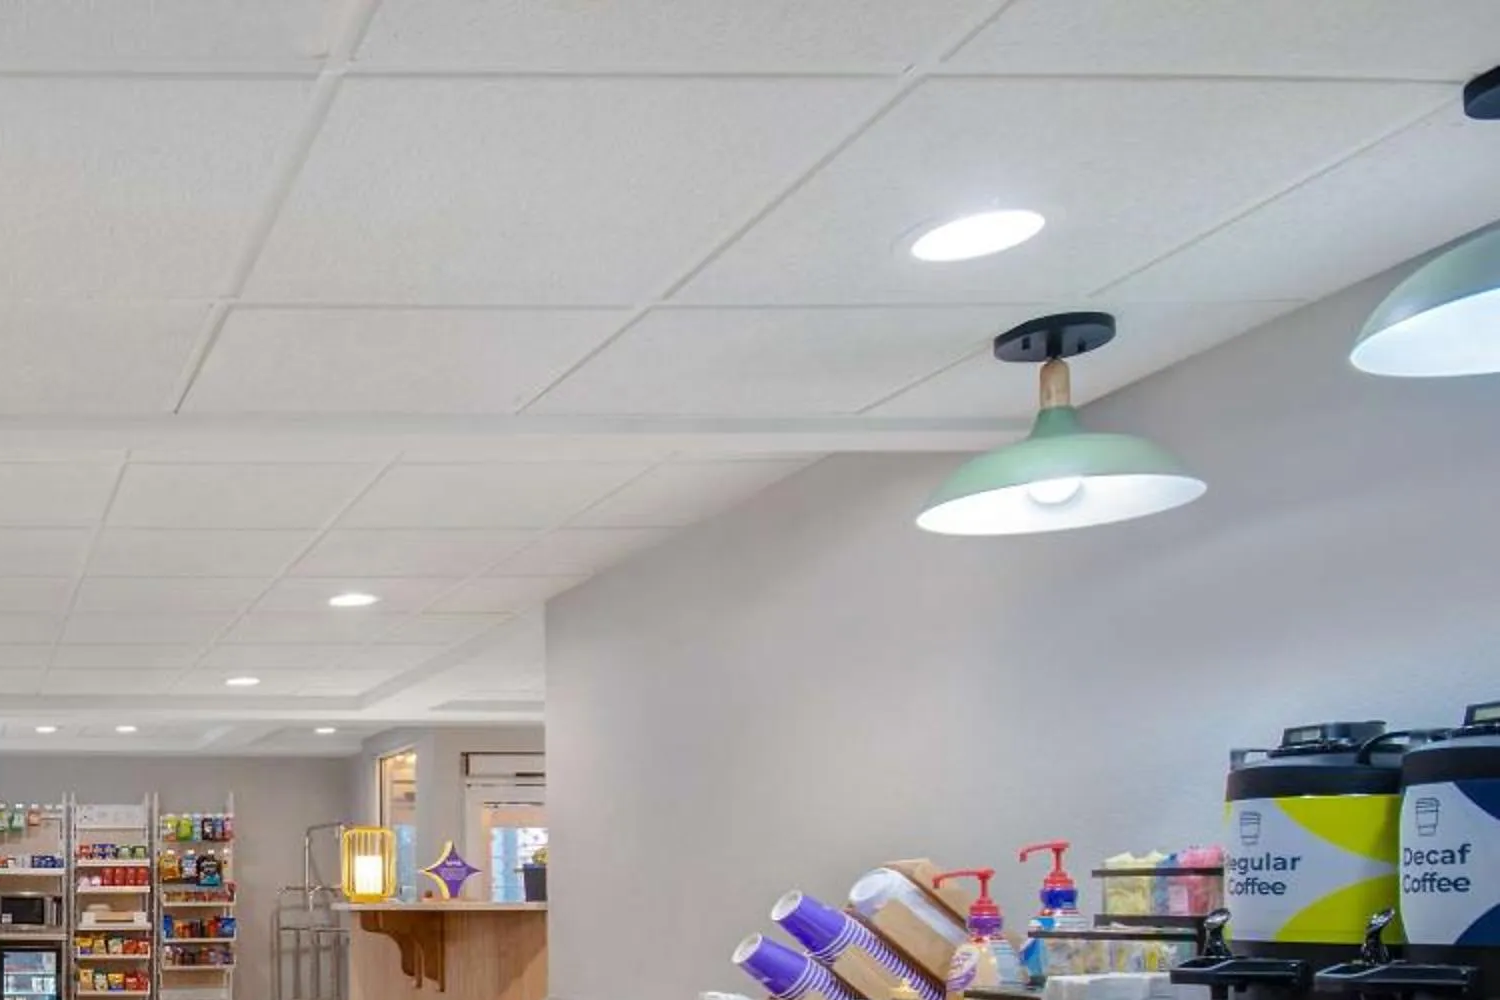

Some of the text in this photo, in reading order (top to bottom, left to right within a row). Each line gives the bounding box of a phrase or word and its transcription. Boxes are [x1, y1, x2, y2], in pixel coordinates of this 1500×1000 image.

[1225, 852, 1302, 875] egular
[1403, 843, 1472, 866] Decaf
[1227, 877, 1287, 896] Coffee
[1403, 871, 1471, 894] Coffee
